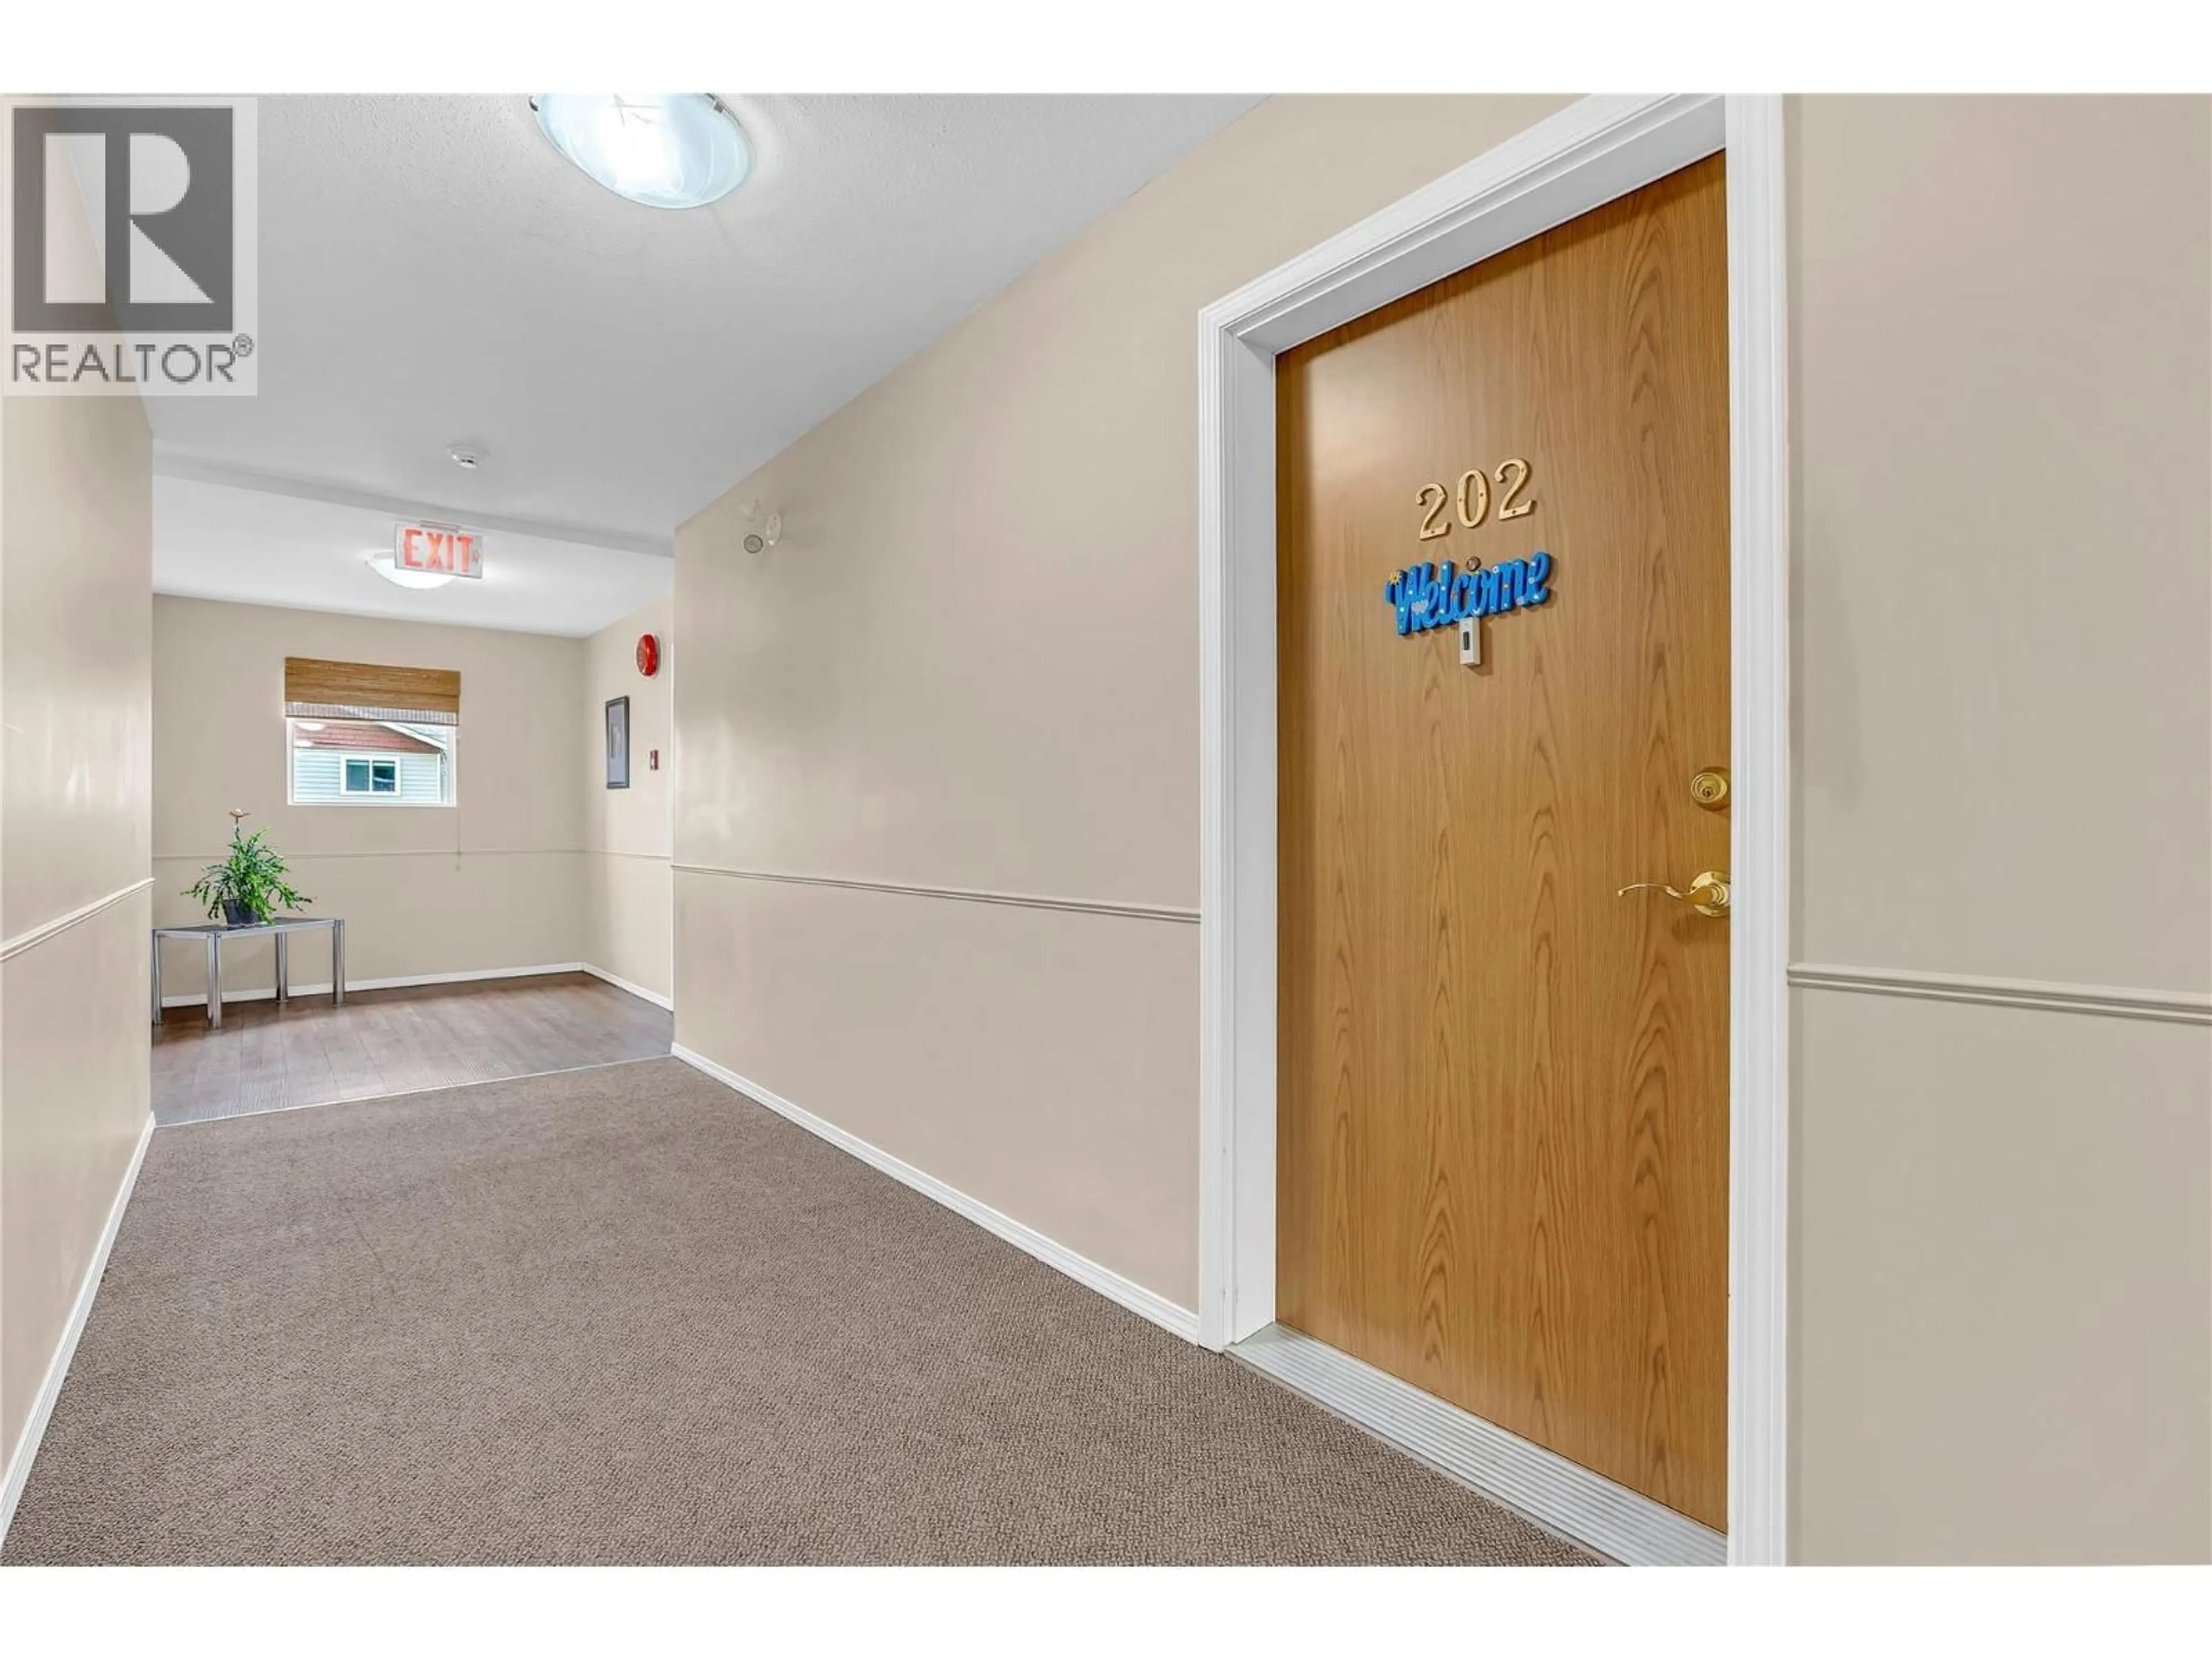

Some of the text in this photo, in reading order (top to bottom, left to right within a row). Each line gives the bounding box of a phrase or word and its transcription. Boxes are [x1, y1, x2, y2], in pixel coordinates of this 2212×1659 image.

[1415, 458, 1535, 540] 202
[404, 528, 474, 573] EXIT
[1385, 551, 1551, 635] Welcome
